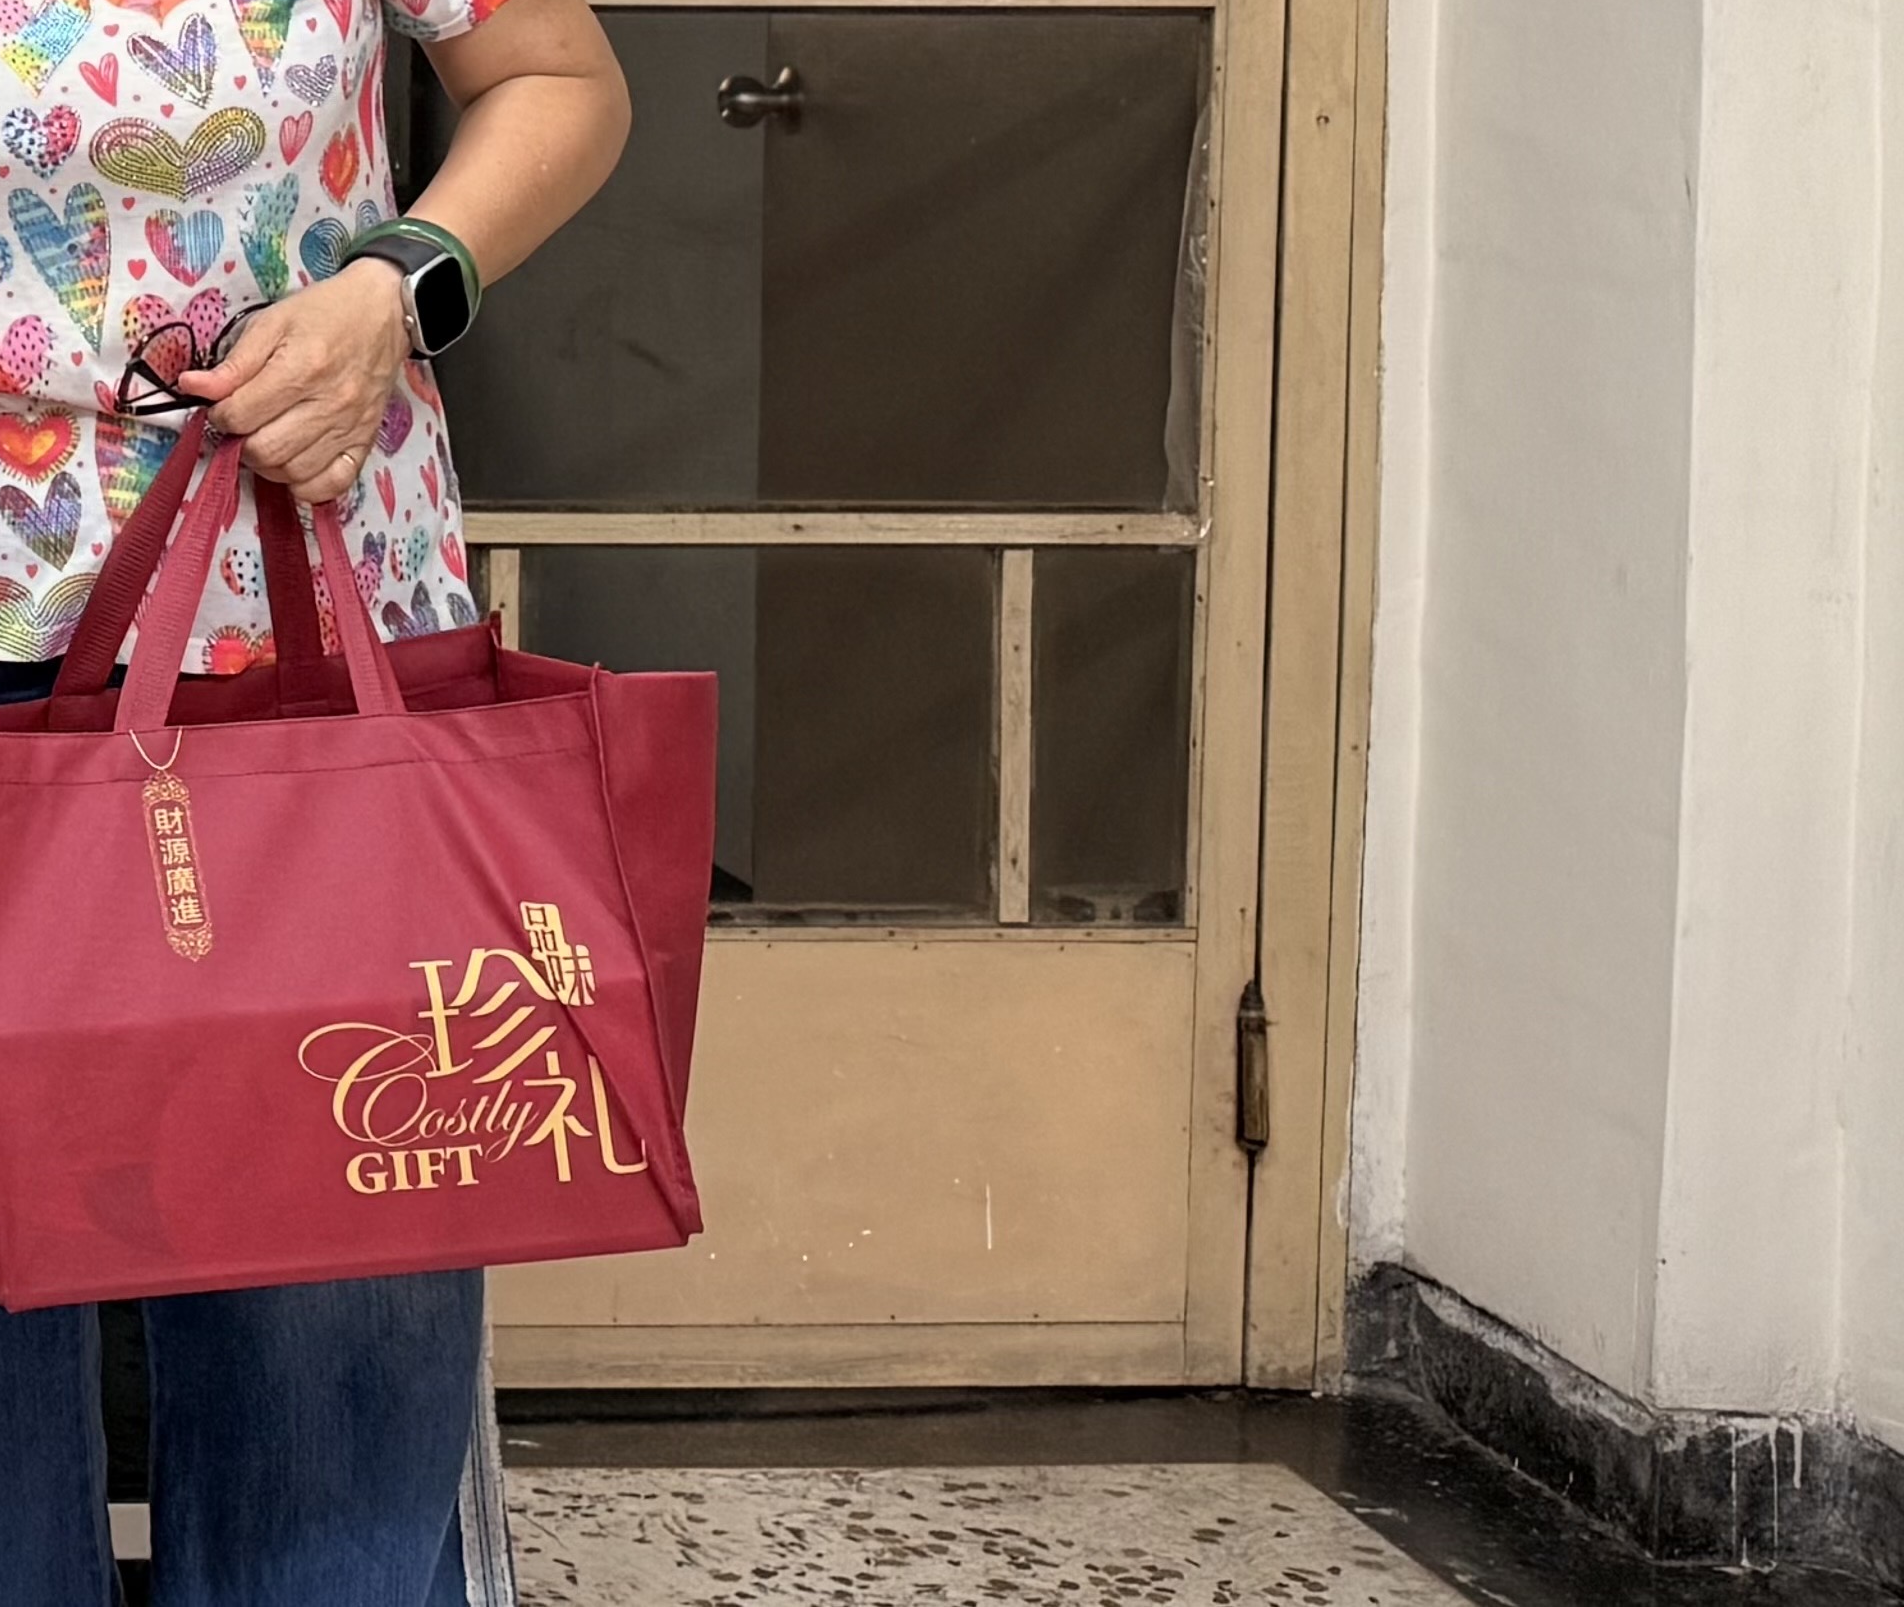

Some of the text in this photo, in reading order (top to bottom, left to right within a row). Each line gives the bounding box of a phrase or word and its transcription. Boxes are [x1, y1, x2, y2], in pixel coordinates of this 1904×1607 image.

[154, 806, 204, 926] 財源廣進
[520, 900, 596, 1006] 品味
[298, 1022, 539, 1163] Costly
[346, 1143, 484, 1195] GIFT
